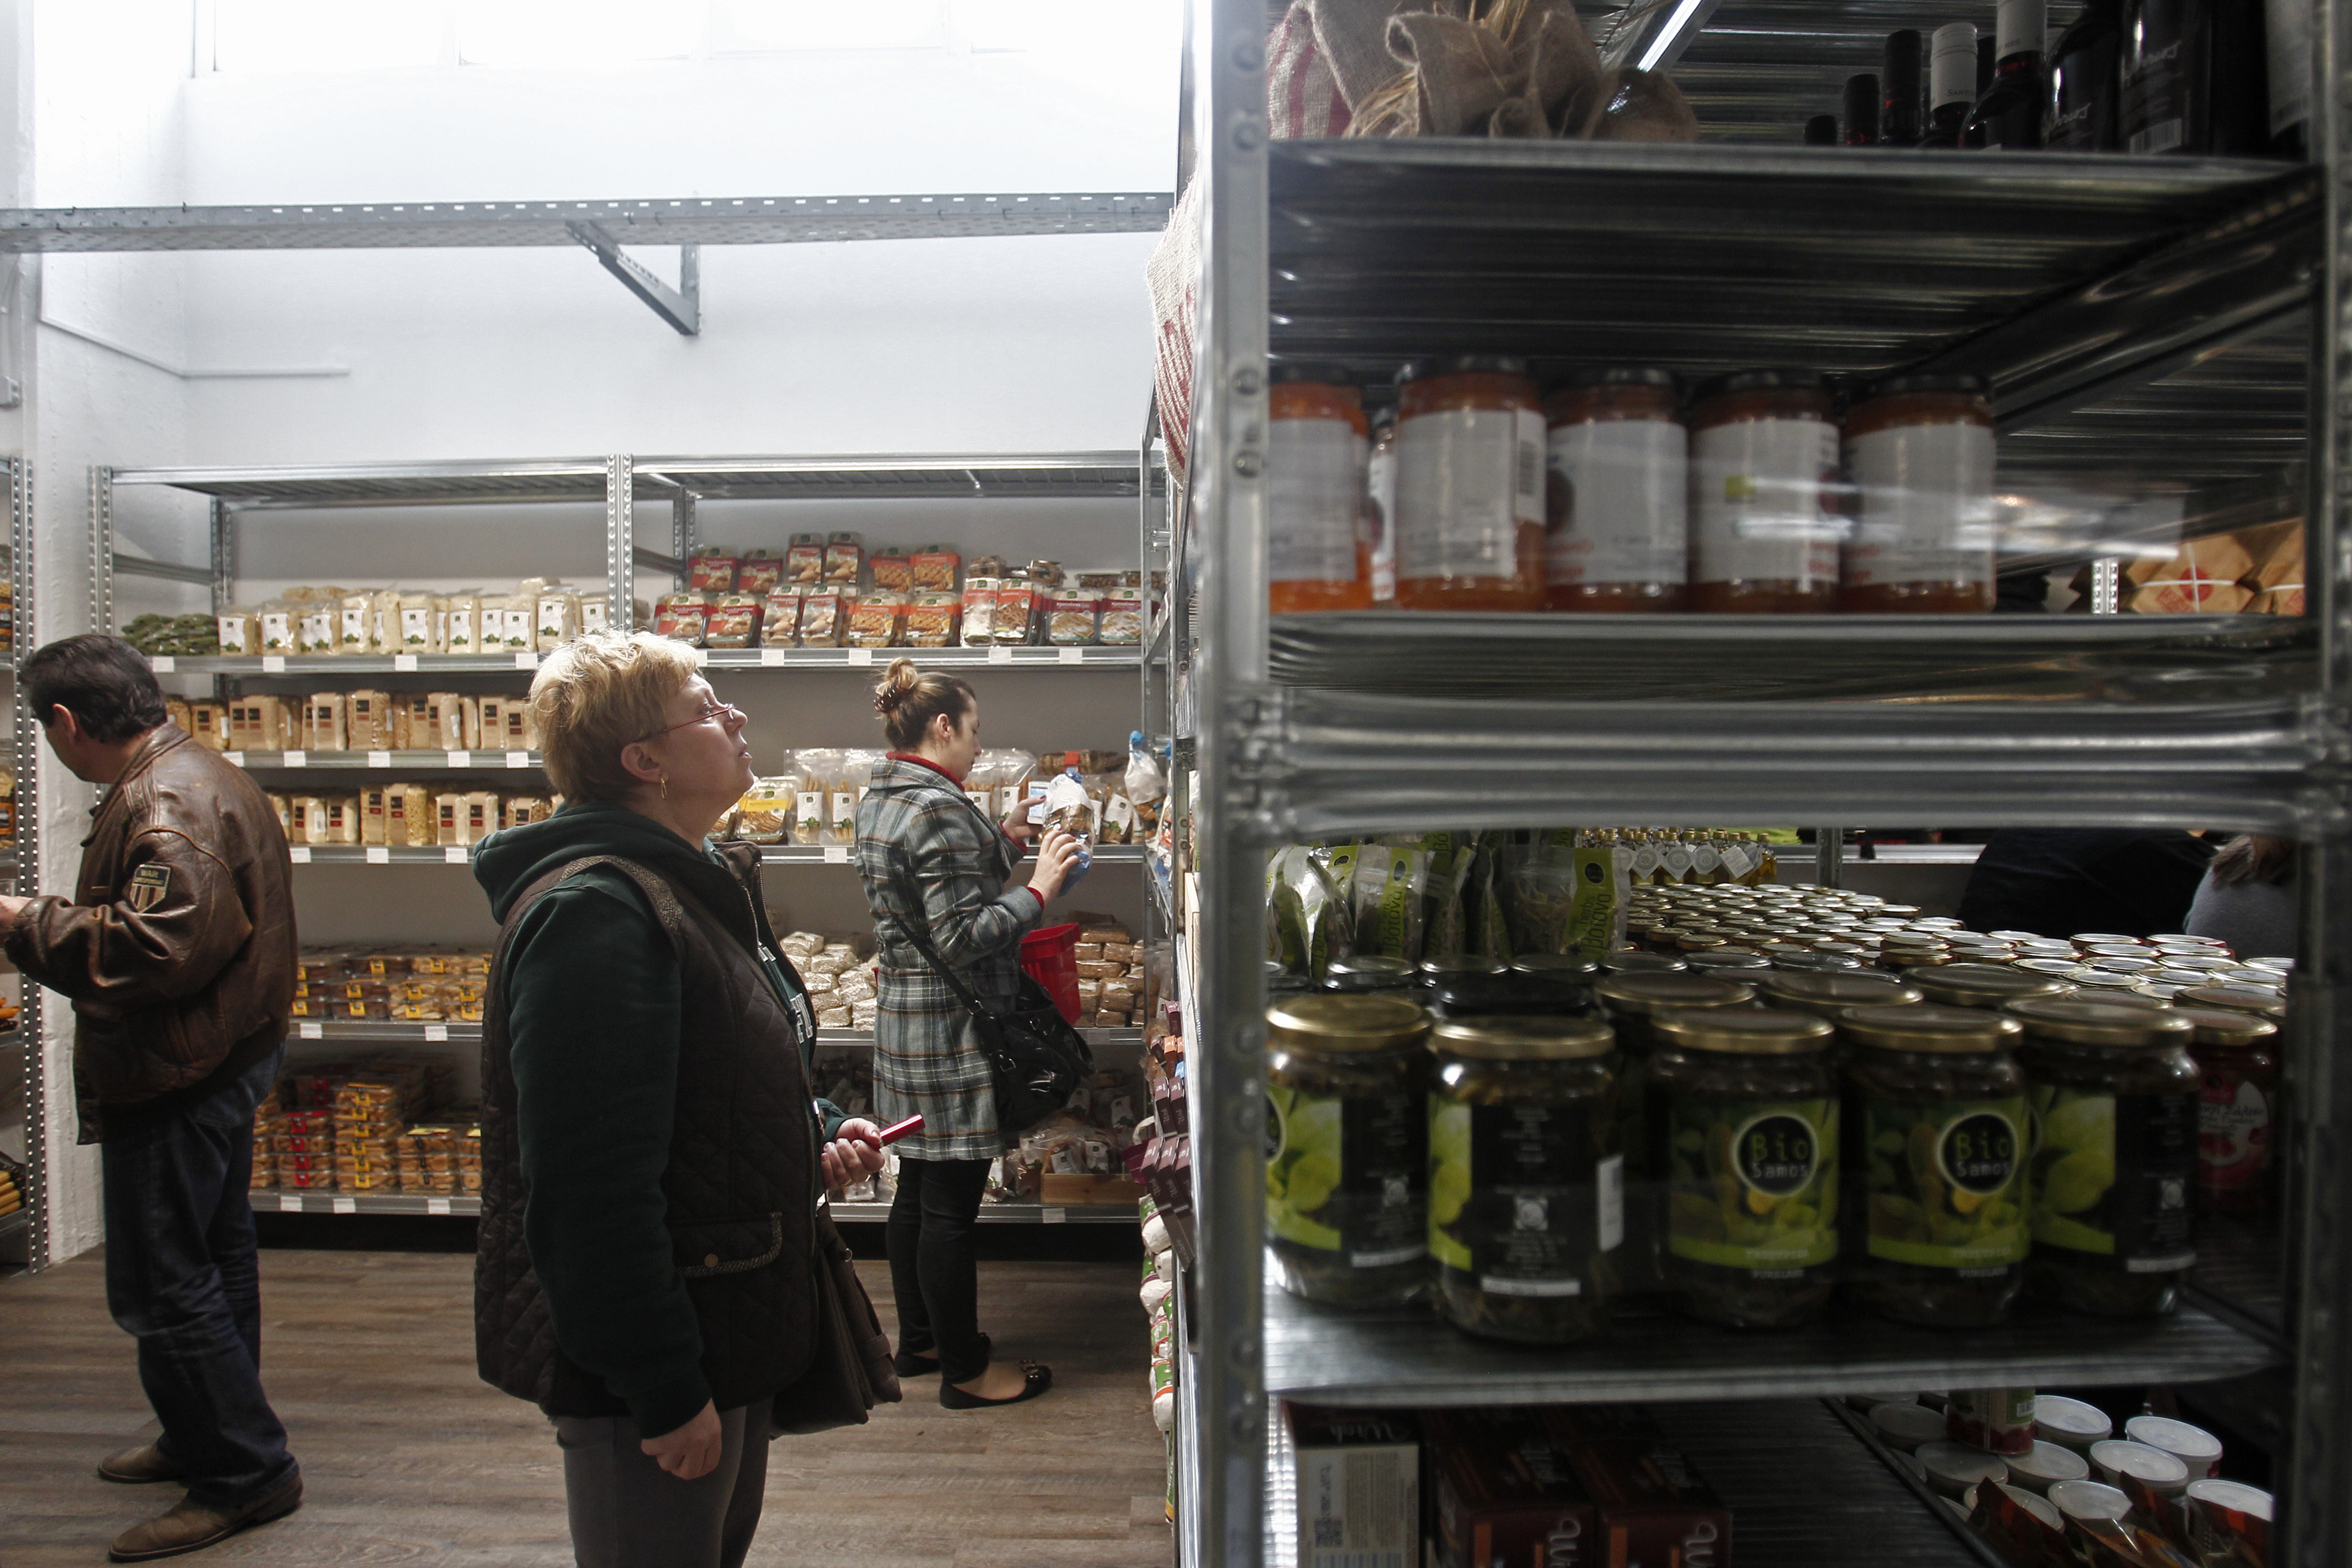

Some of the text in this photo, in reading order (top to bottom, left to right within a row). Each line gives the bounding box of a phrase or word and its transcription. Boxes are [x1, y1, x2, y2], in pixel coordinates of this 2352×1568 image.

[1576, 896, 1596, 925] herbs
[1580, 893, 1612, 951] βότανα
[1749, 1131, 1809, 1161] Bio
[1954, 1131, 2011, 1160] Bio
[1751, 1162, 1808, 1179] Samos
[1956, 1161, 2011, 1178] Samos
